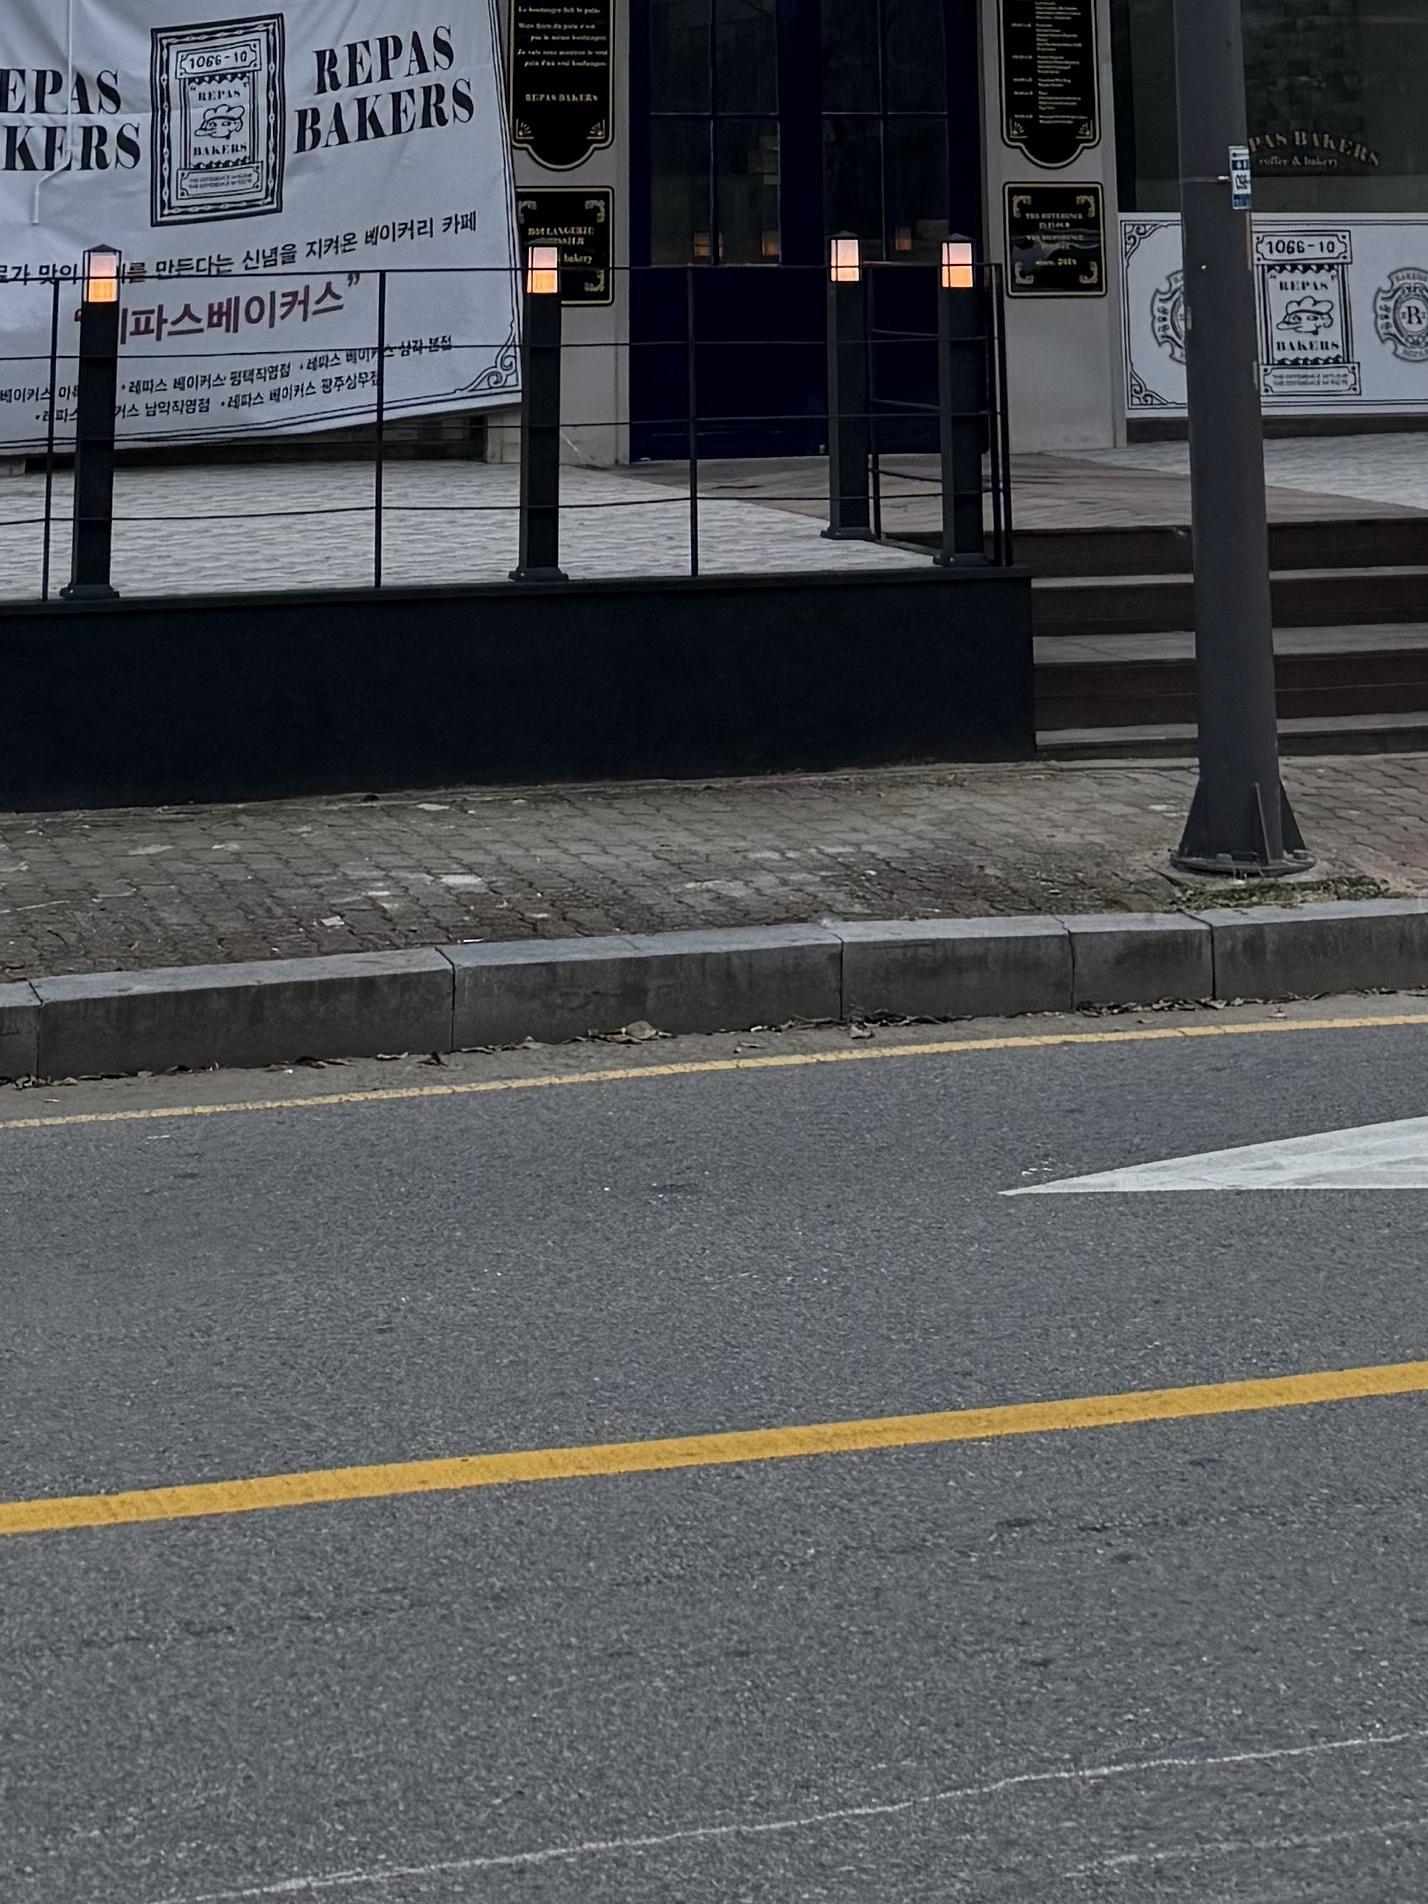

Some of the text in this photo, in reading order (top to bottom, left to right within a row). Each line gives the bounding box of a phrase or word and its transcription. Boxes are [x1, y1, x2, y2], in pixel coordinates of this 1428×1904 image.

[188, 50, 249, 70] 1066-10
[311, 25, 456, 96] REPAS
[197, 89, 241, 102] REPAS
[292, 78, 476, 154] BAKERS
[192, 142, 249, 157] BAKERS
[1248, 131, 1380, 167] PAS BAKERS
[241, 242, 298, 271] 신념을
[305, 231, 359, 260] 지켜온
[364, 216, 435, 247] 베이커리
[441, 210, 478, 235] 카페
[1266, 239, 1336, 255] 1066-10
[1278, 279, 1330, 292] REPAS
[74, 272, 362, 345] “파스베이커스”
[1405, 305, 1423, 325] R
[1276, 340, 1340, 352] BAKERS
[306, 352, 342, 372] 레파스
[128, 377, 168, 394] 레파스
[173, 373, 225, 392] 베이커스
[227, 391, 265, 410] 레파스
